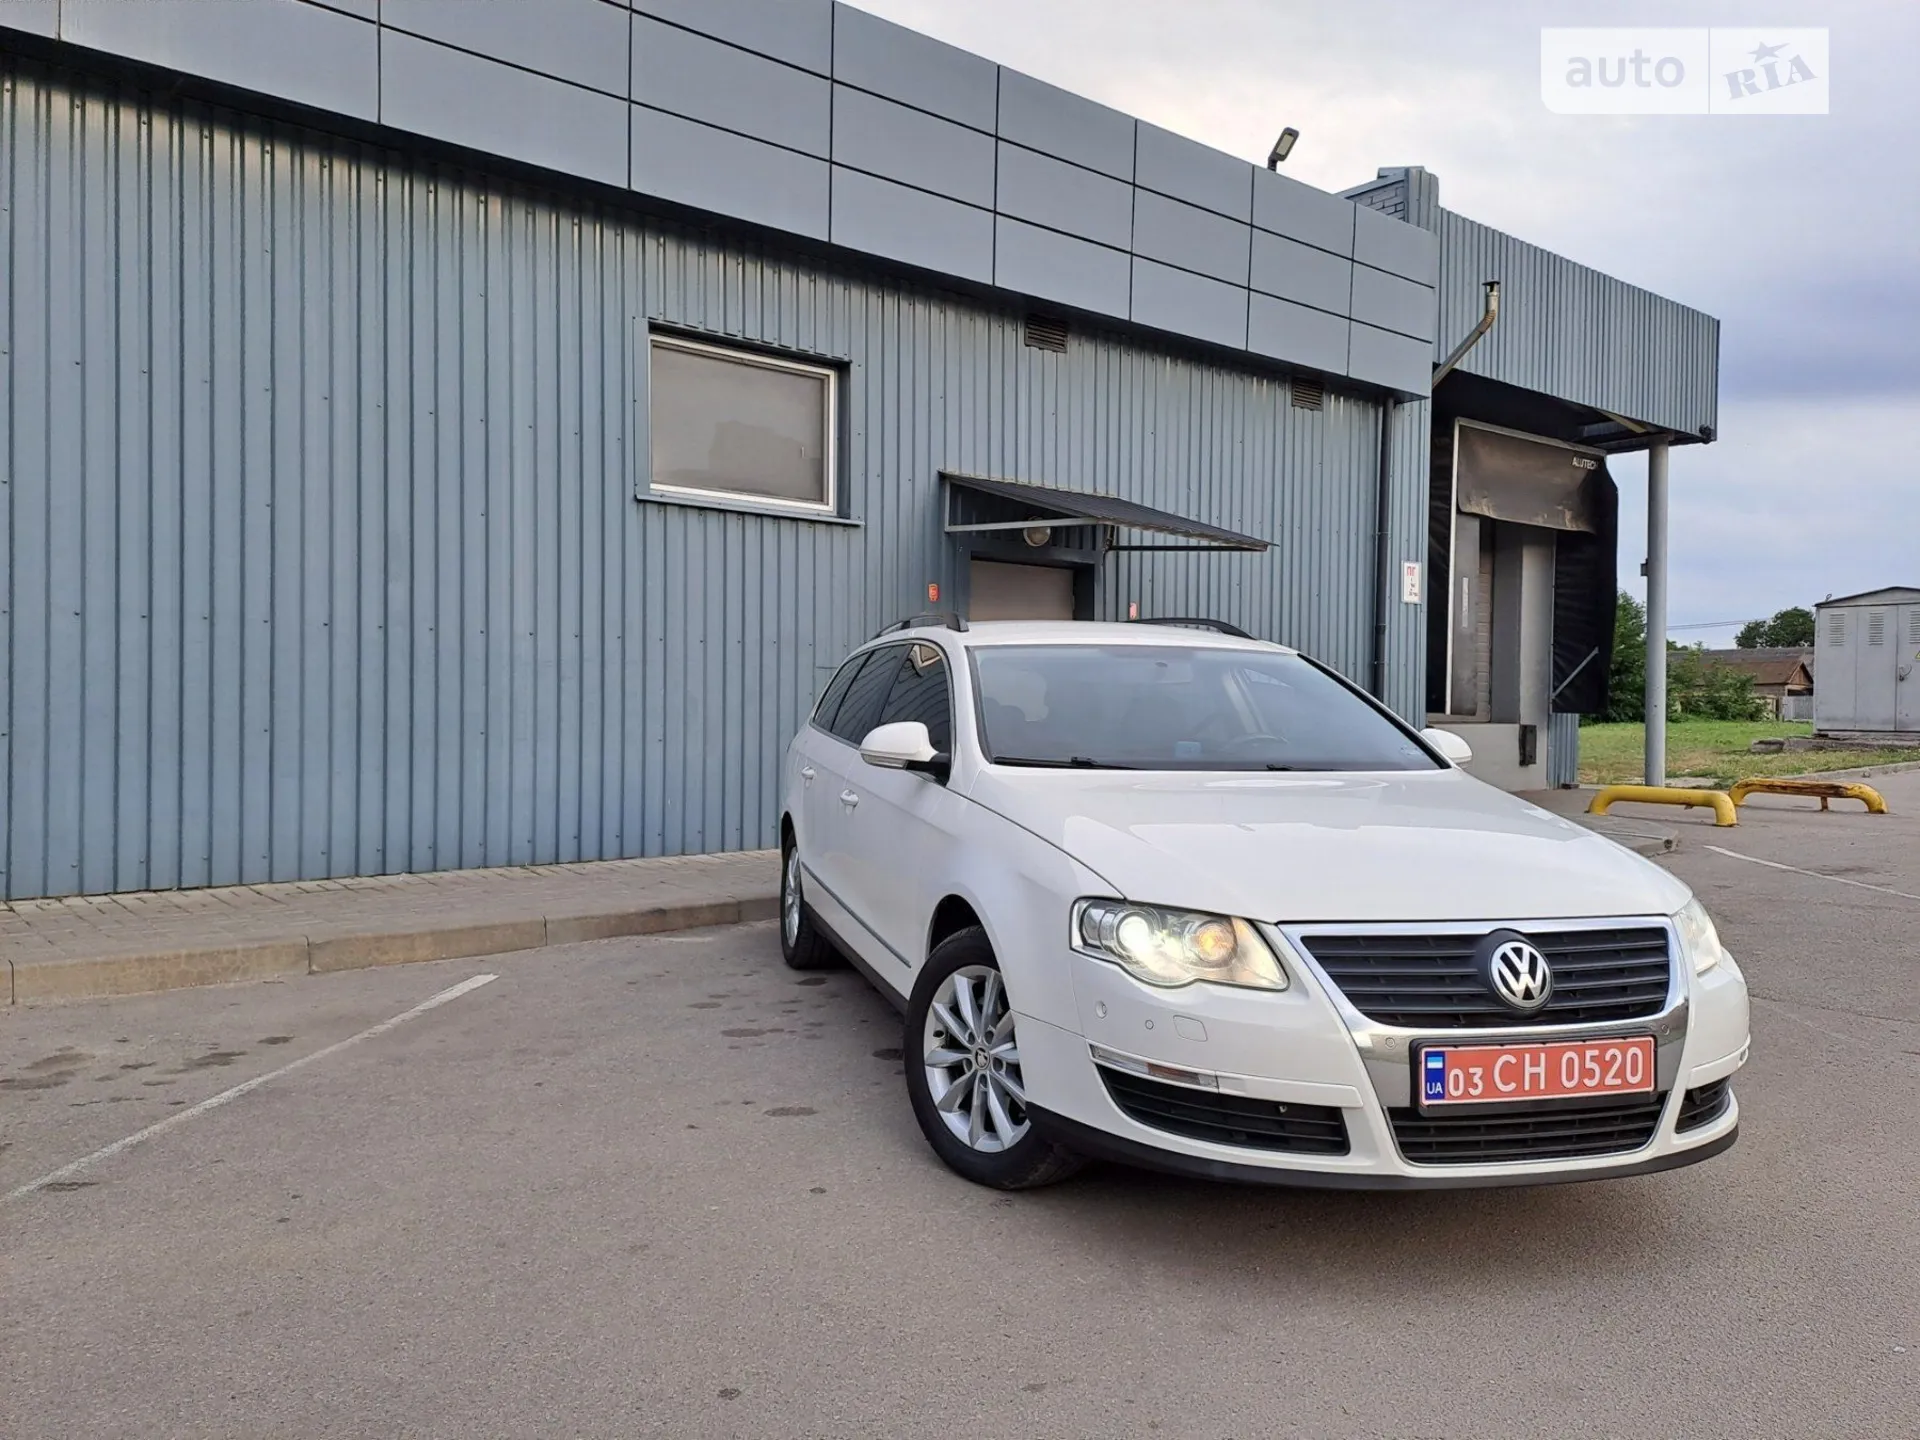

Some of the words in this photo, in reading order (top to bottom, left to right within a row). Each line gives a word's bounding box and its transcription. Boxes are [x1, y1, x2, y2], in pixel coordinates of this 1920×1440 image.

[1491, 941, 1549, 1009] VW
[1426, 1081, 1443, 1095] UA
[1447, 1067, 1484, 1097] 03
[1492, 1053, 1546, 1093] CH
[1560, 1046, 1644, 1089] 0520
